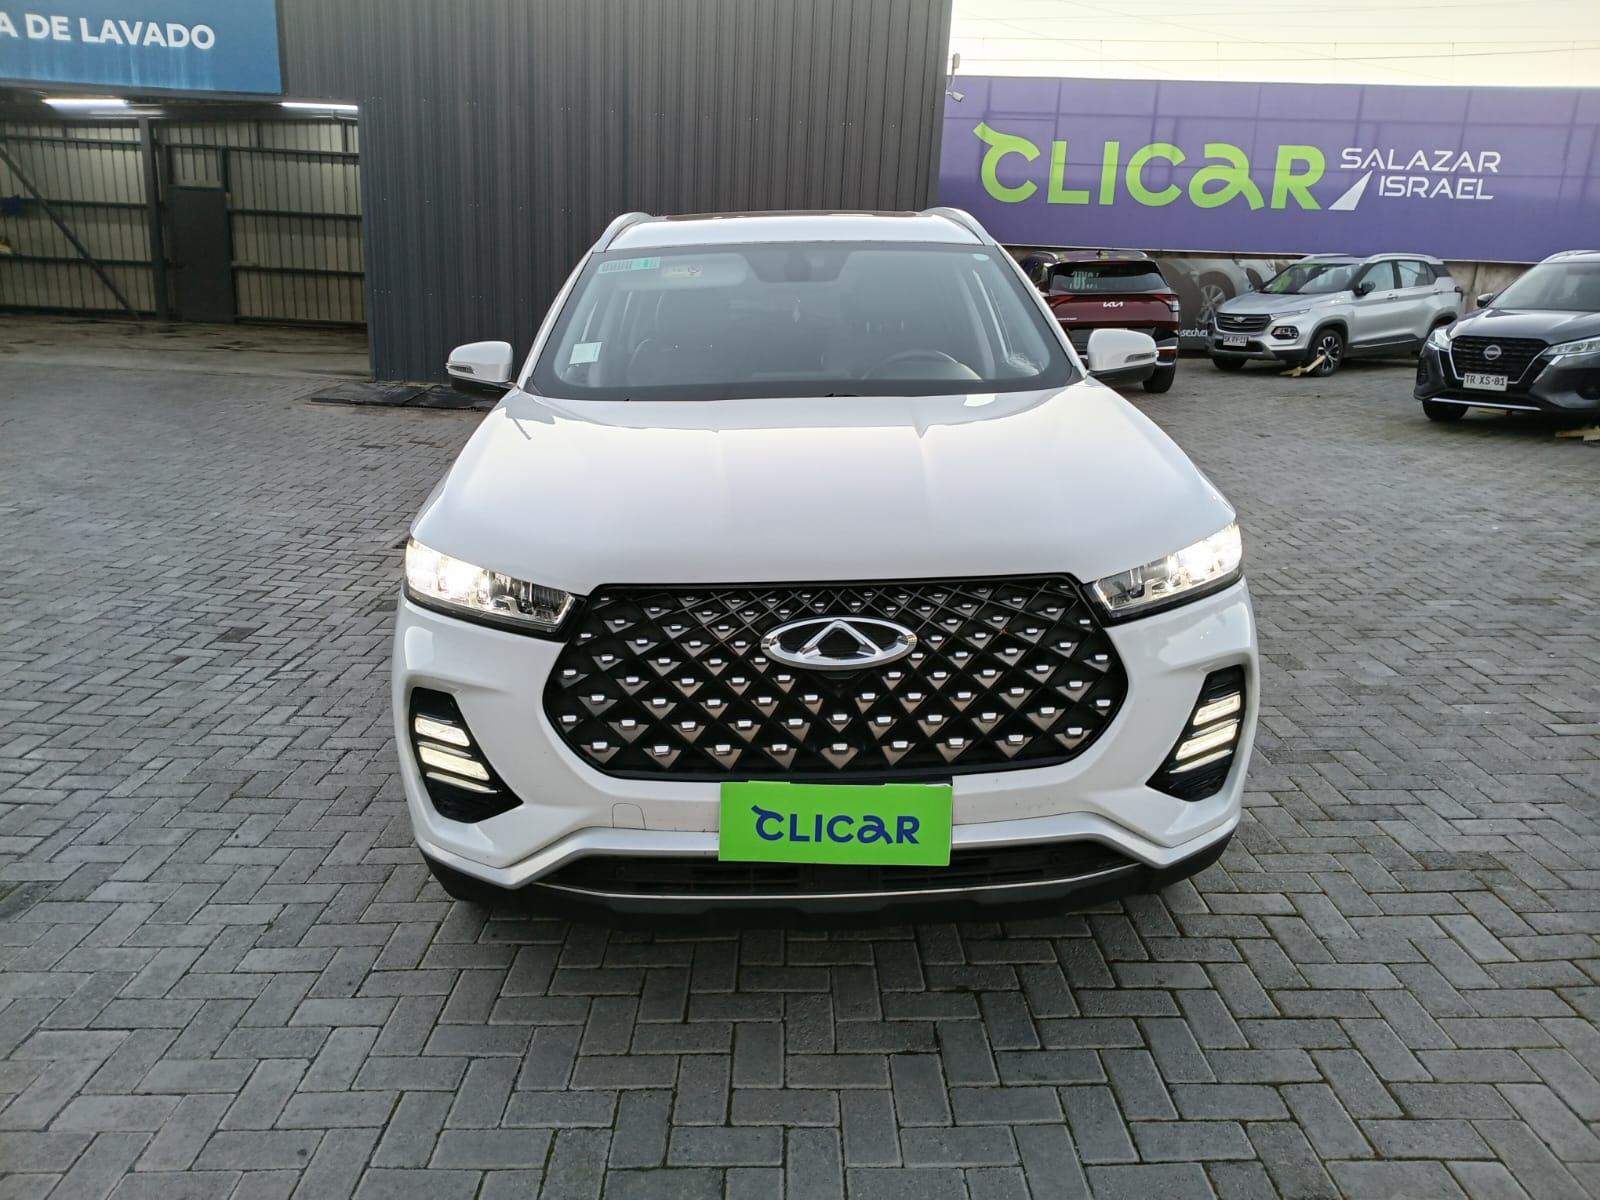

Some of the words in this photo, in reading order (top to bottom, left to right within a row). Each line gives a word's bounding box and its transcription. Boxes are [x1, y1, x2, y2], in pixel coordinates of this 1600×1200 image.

[25, 13, 71, 41] DE
[79, 17, 216, 50] LAVADO
[1340, 148, 1502, 173] SALAZAR
[1379, 175, 1495, 200] ISRAEL
